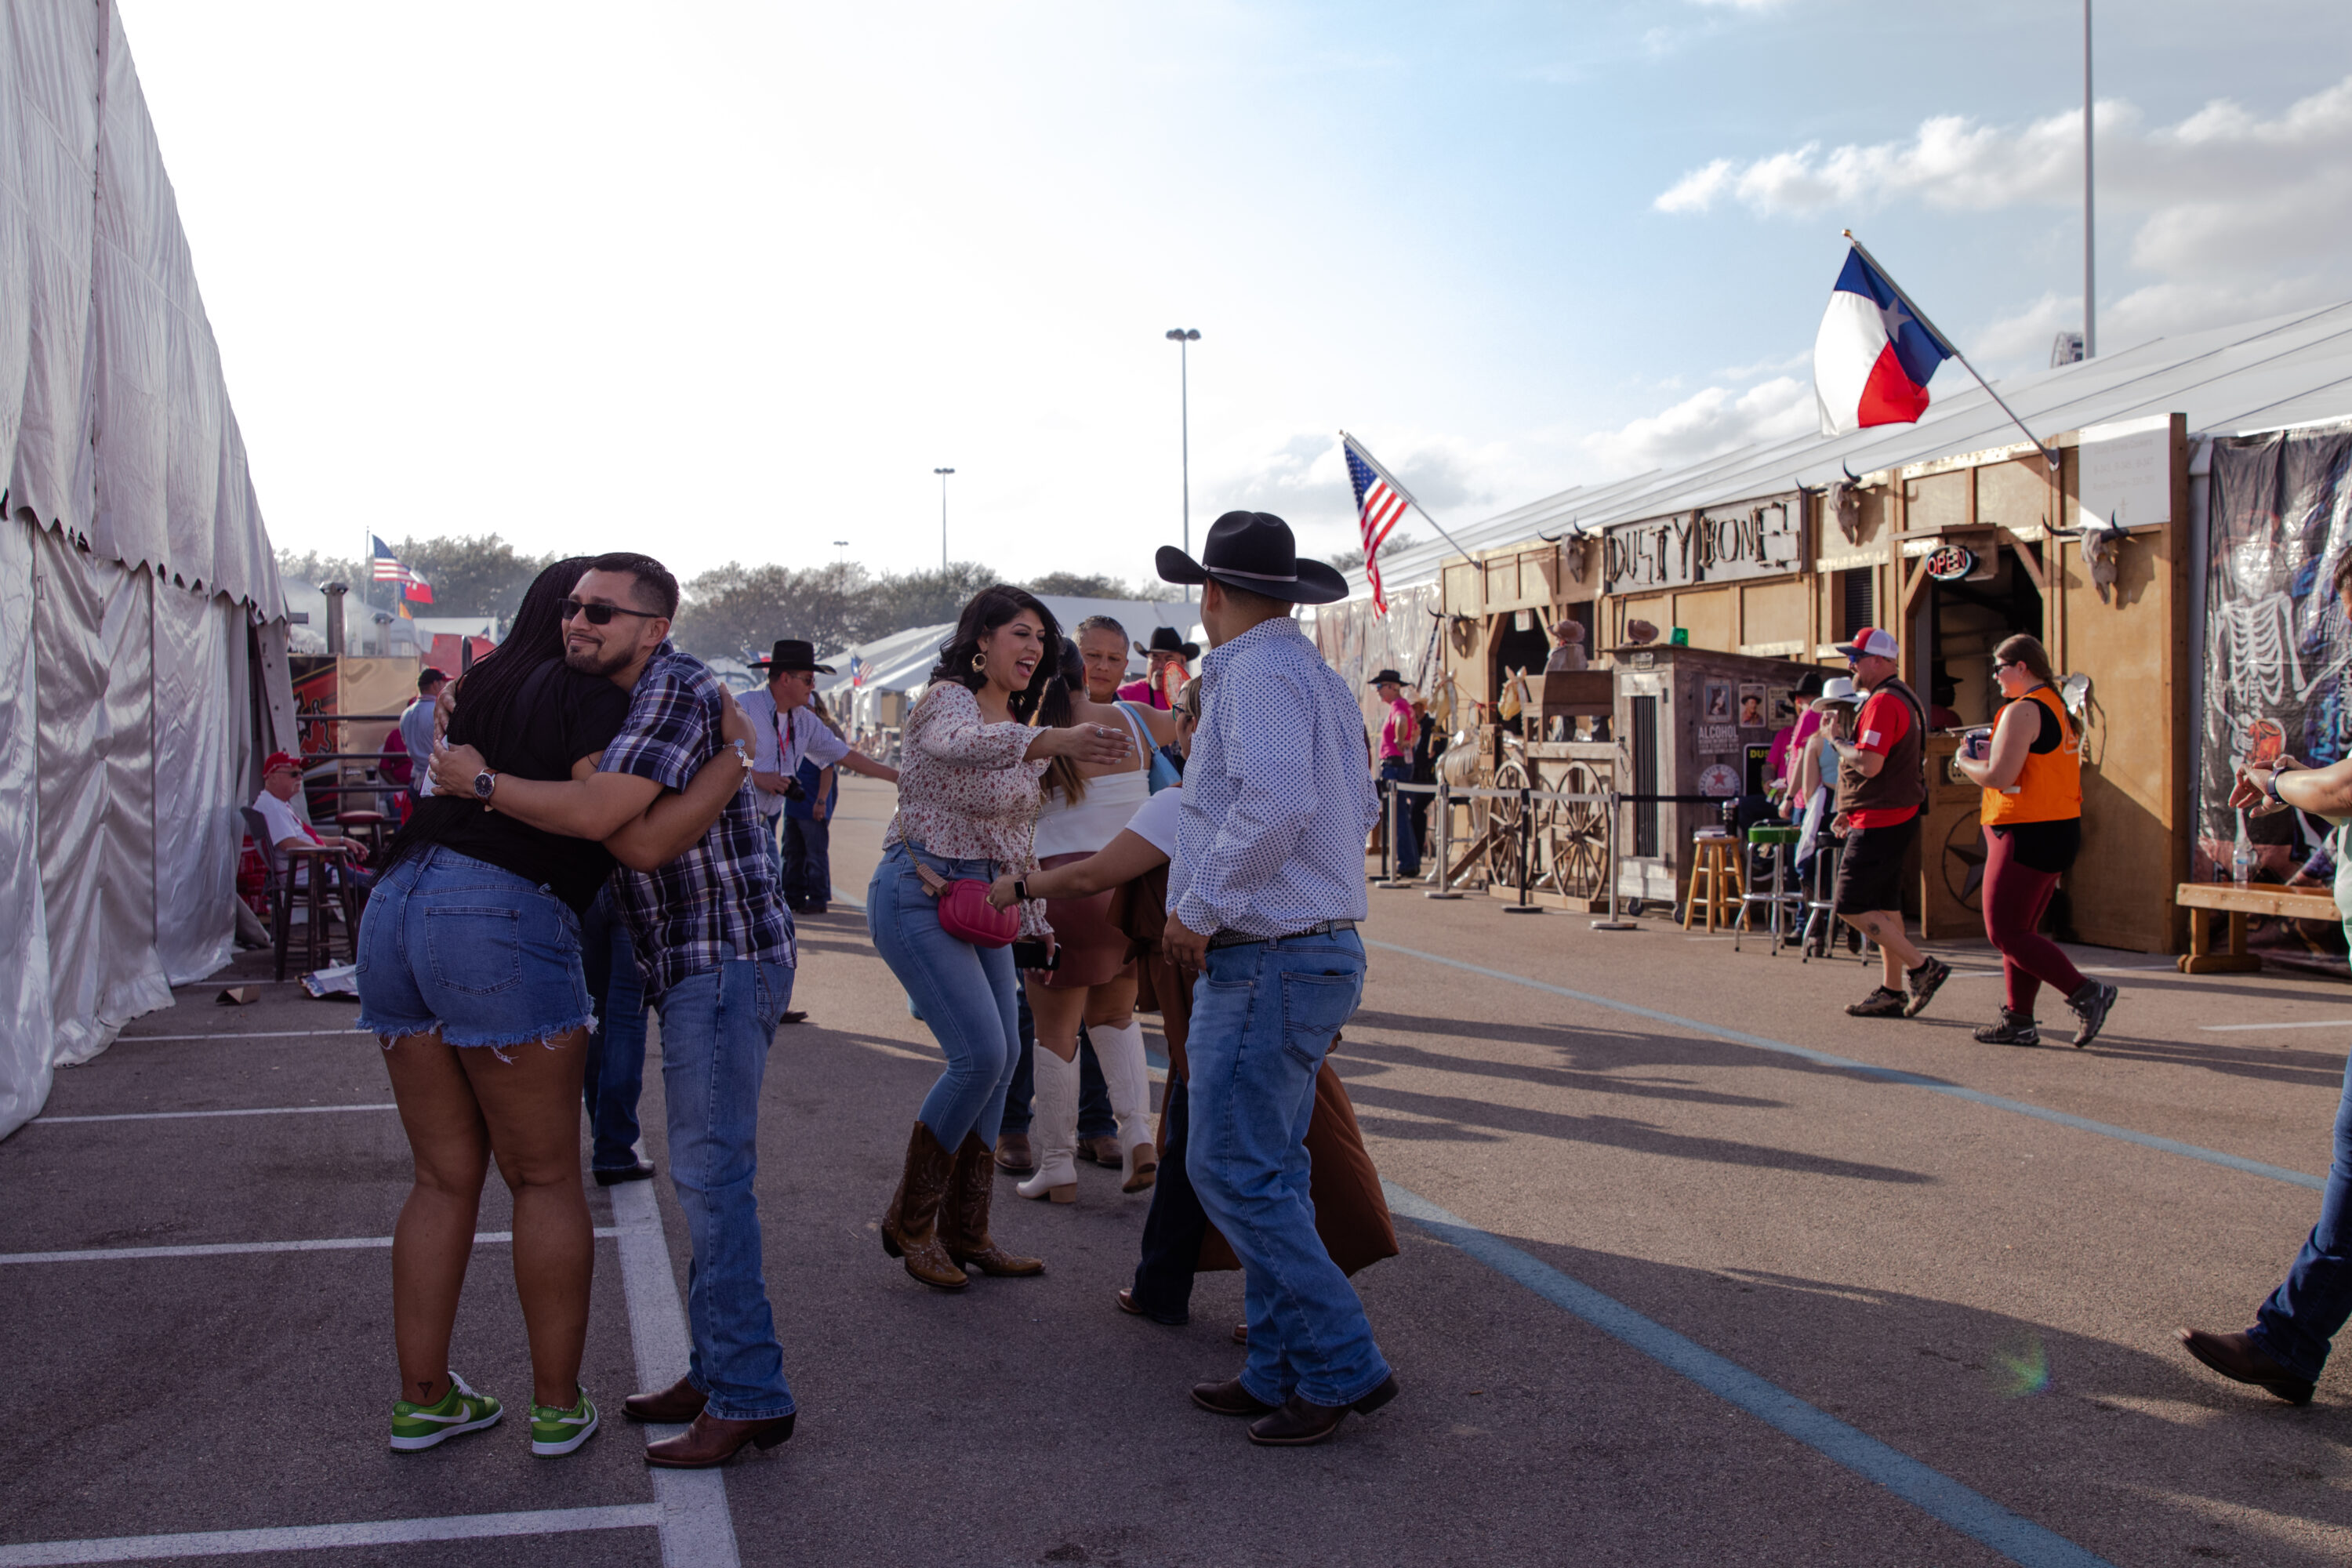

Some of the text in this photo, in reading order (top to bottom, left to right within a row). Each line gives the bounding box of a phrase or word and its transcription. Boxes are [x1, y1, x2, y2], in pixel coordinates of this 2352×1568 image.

[1606, 496, 1800, 584] DUSTY BONES
[1927, 547, 1966, 575] OPEN
[1698, 725, 1739, 739] ALCOHOL
